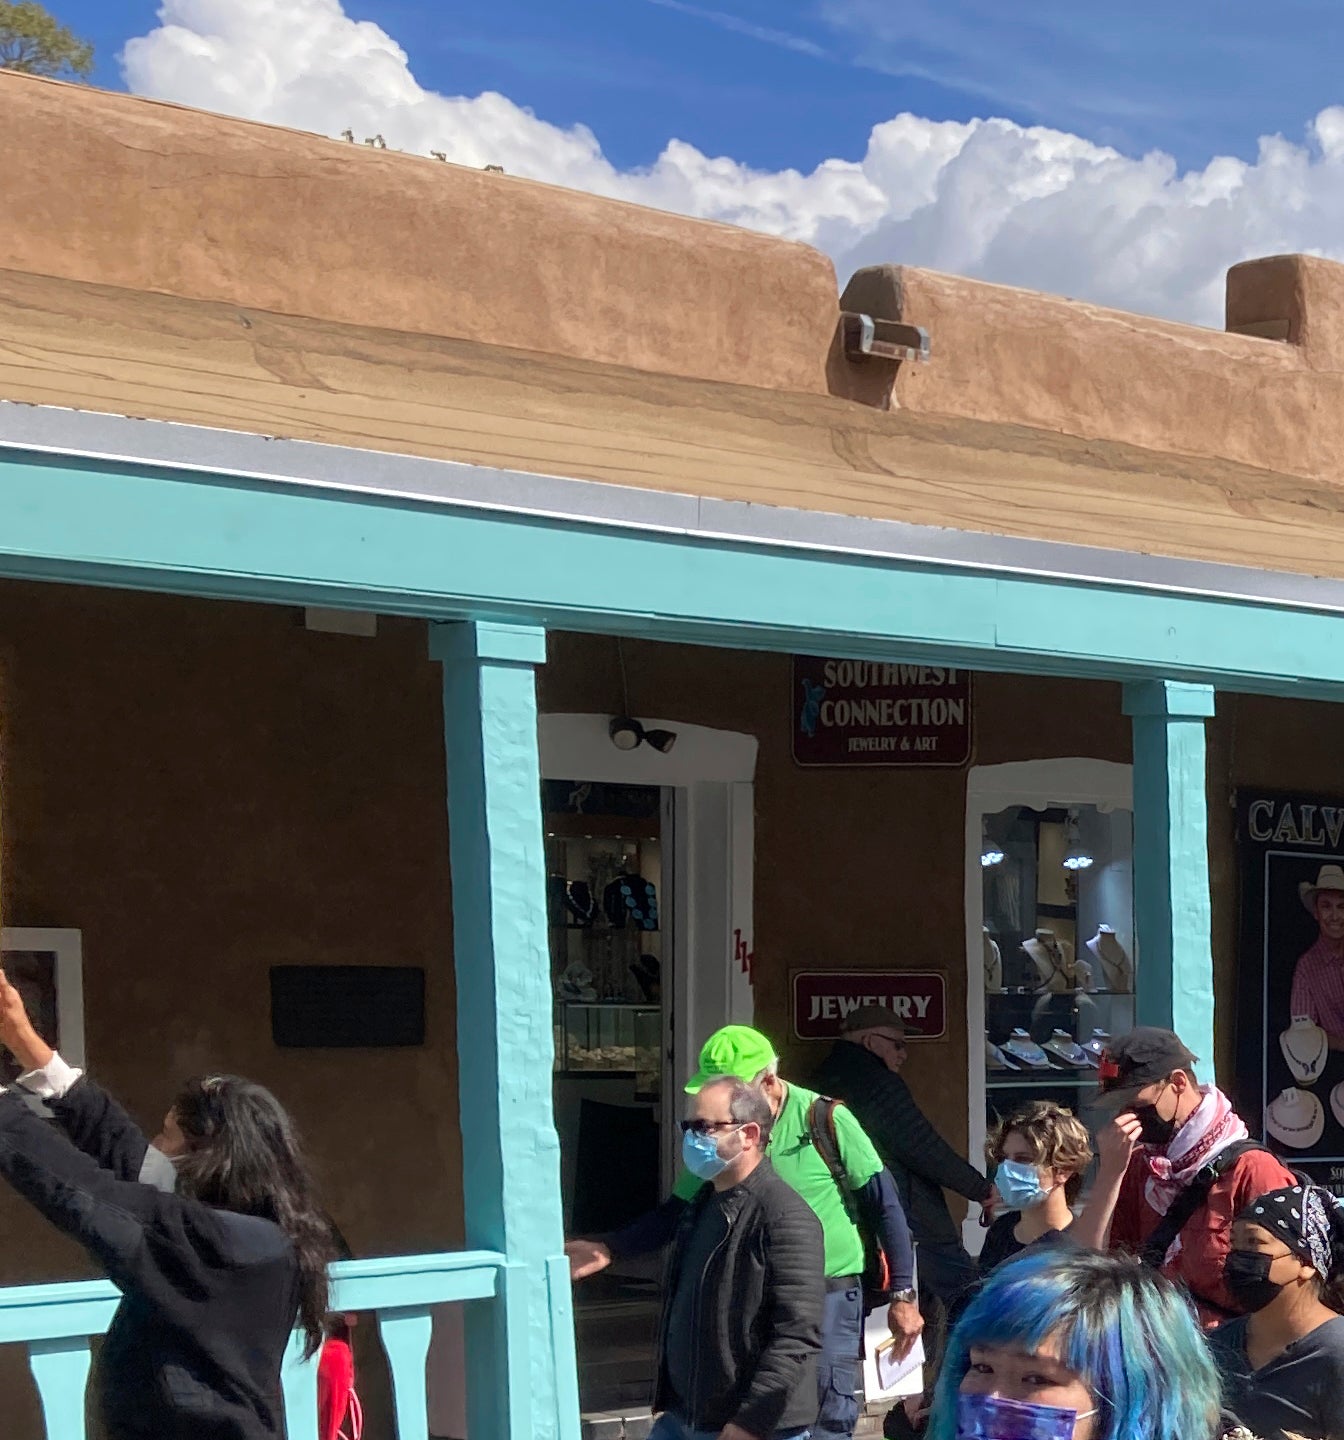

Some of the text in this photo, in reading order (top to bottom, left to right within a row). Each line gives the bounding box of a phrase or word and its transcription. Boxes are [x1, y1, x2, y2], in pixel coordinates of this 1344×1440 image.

[823, 660, 958, 688] SOUTHWEST
[820, 699, 965, 727] CONNECTION
[848, 736, 938, 752] JEWELRY & ART
